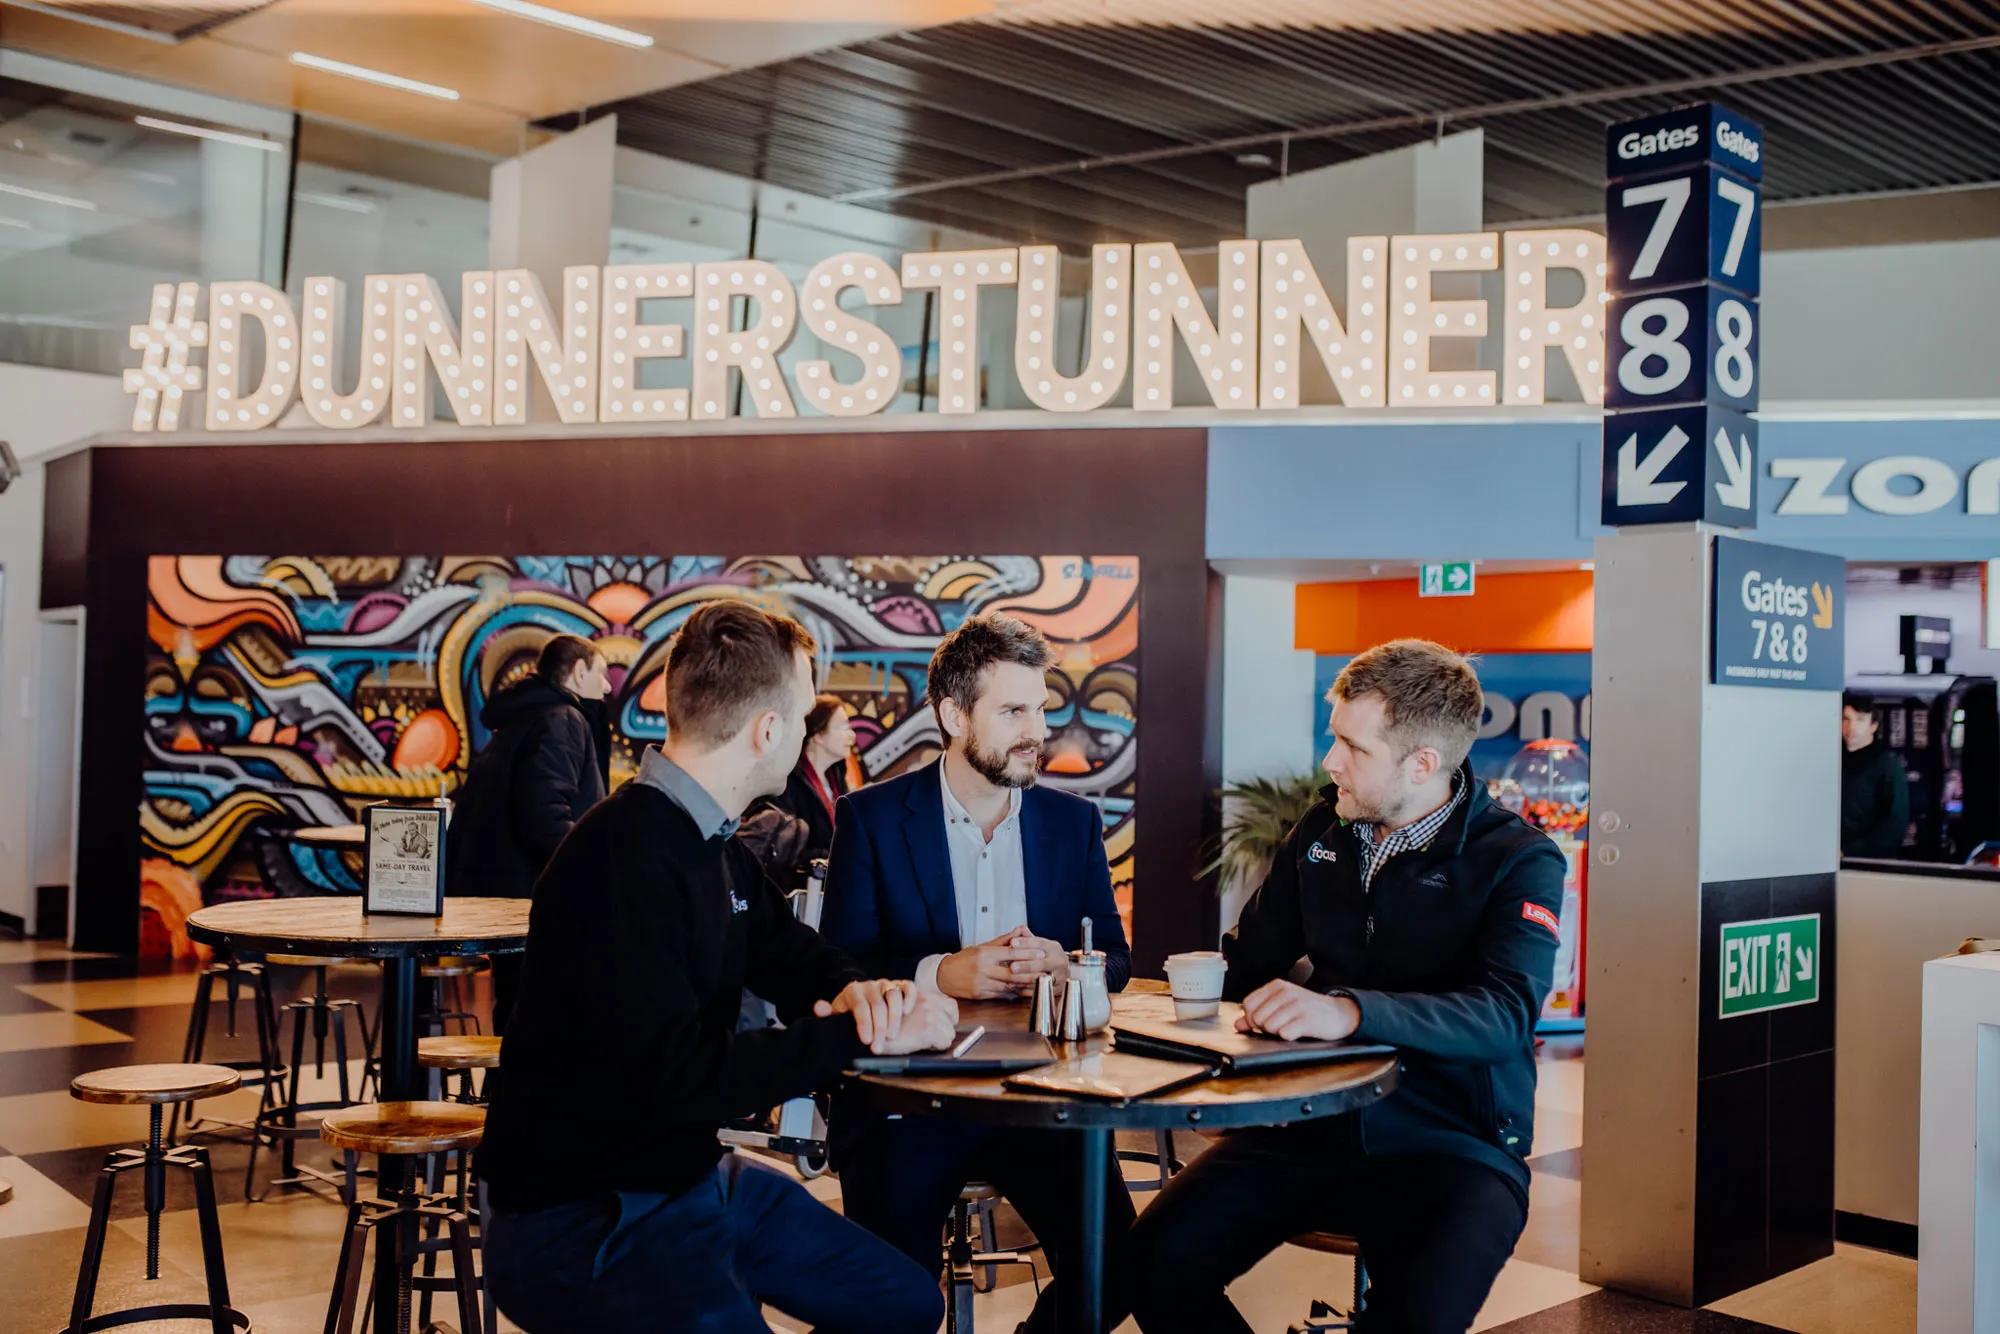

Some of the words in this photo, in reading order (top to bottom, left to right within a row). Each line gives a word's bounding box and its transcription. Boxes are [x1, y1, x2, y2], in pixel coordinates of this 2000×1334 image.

[1617, 124, 1699, 160] Gates
[1716, 121, 1760, 163] Gates
[1622, 176, 1692, 281] 7
[1717, 176, 1755, 278] 7
[123, 228, 1607, 433] #DUNNERSTUNNER
[1617, 297, 1692, 396] 8
[1714, 298, 1754, 399] 8
[1741, 569, 1808, 617] Gates
[375, 863, 406, 871] SAME-DAY
[407, 864, 432, 872] TRAVEL
[1724, 934, 1772, 1000] EXIT
